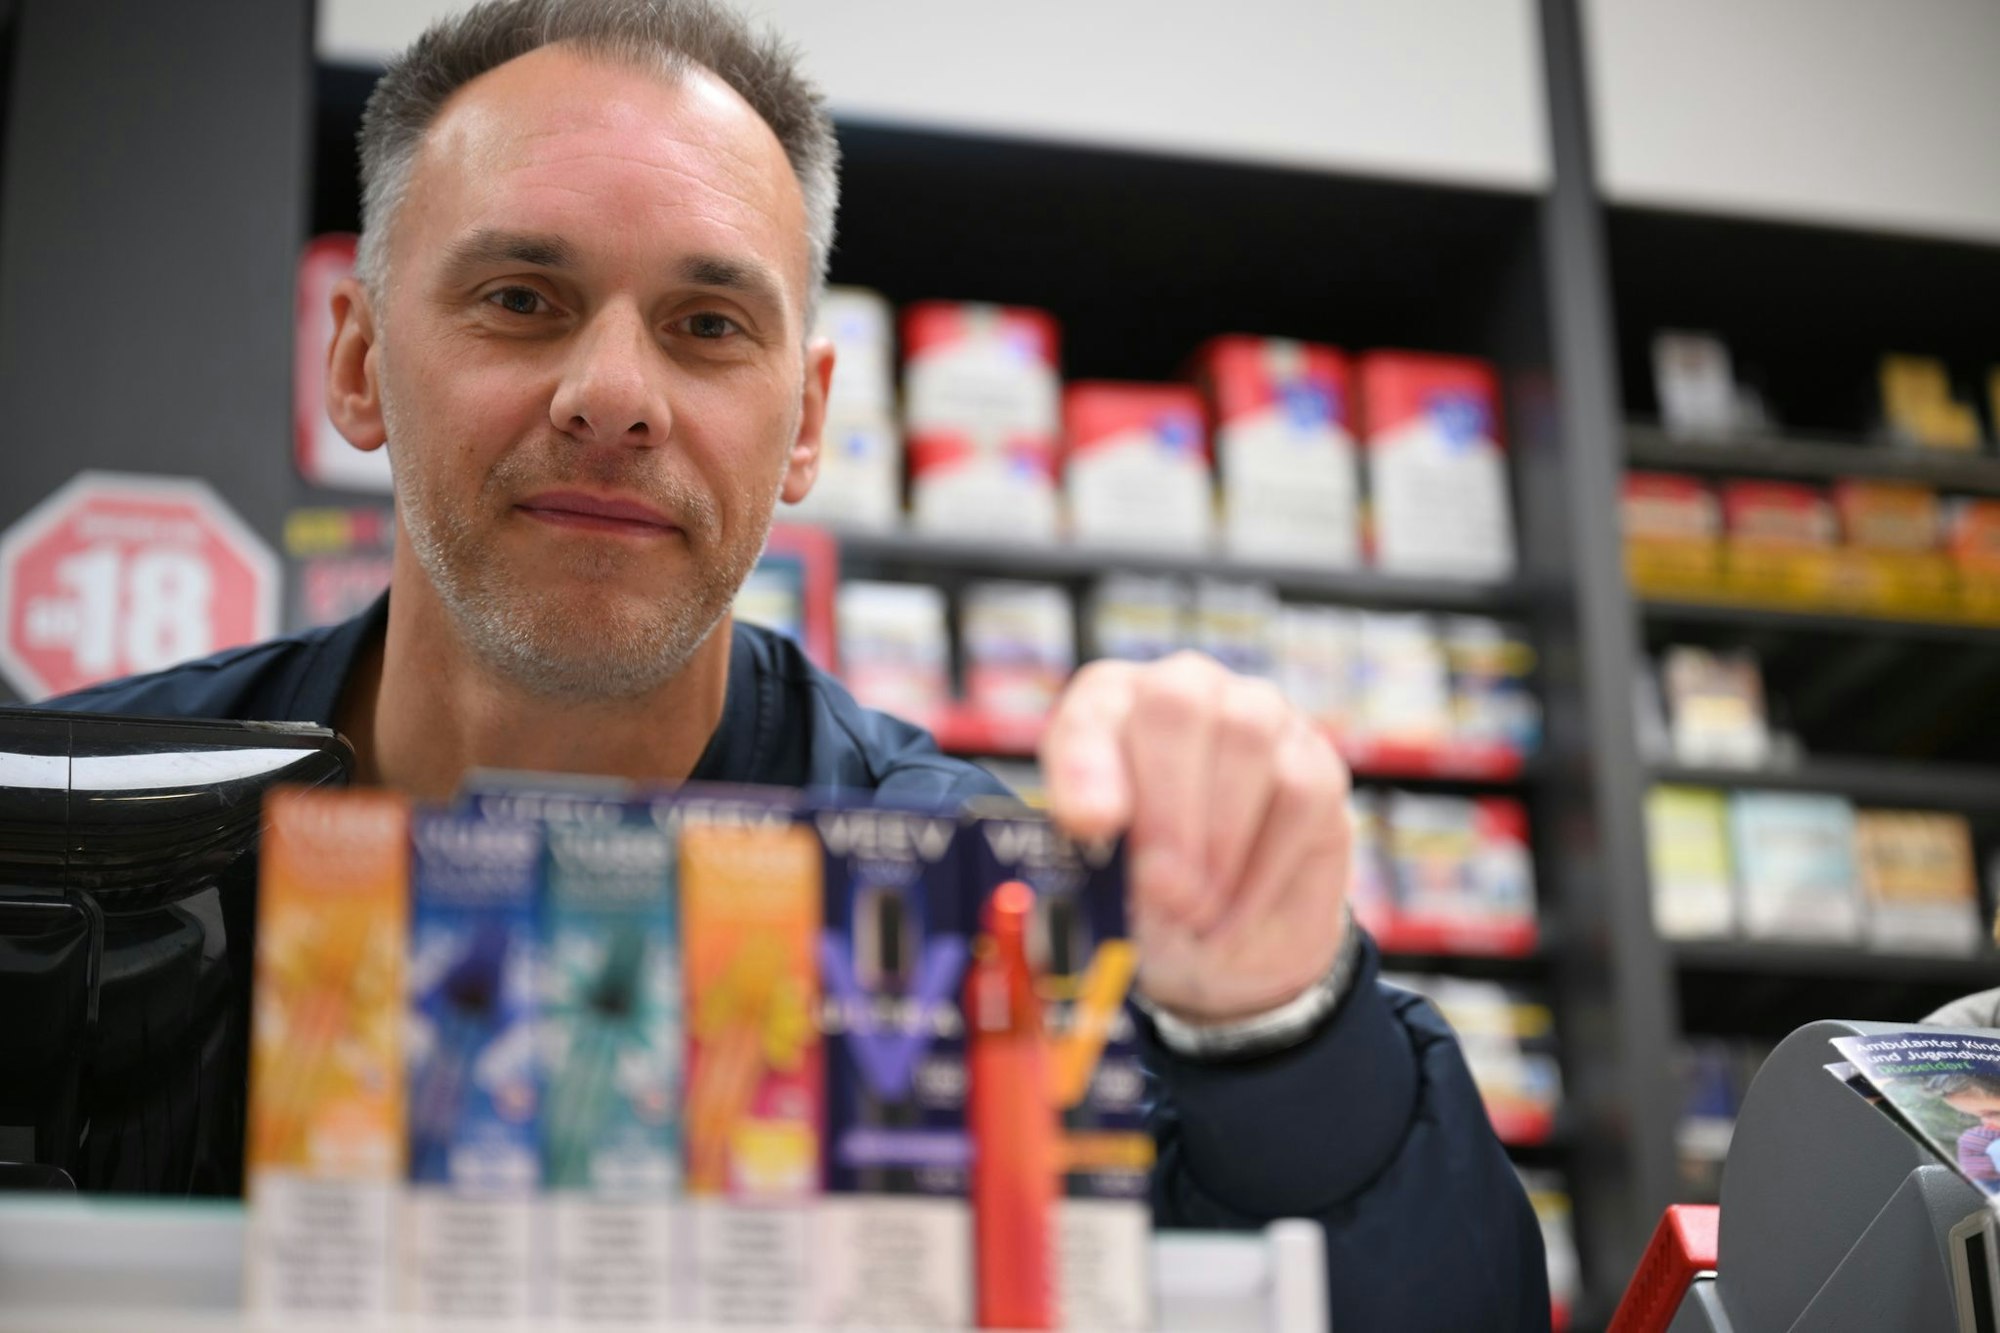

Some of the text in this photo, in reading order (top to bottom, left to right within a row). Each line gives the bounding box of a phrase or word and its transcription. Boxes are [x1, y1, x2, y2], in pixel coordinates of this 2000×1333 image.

[1857, 1039, 1958, 1051] Ambulanter
[1866, 1051, 1902, 1063] und
[1876, 1060, 1975, 1074] Düsseldorf
